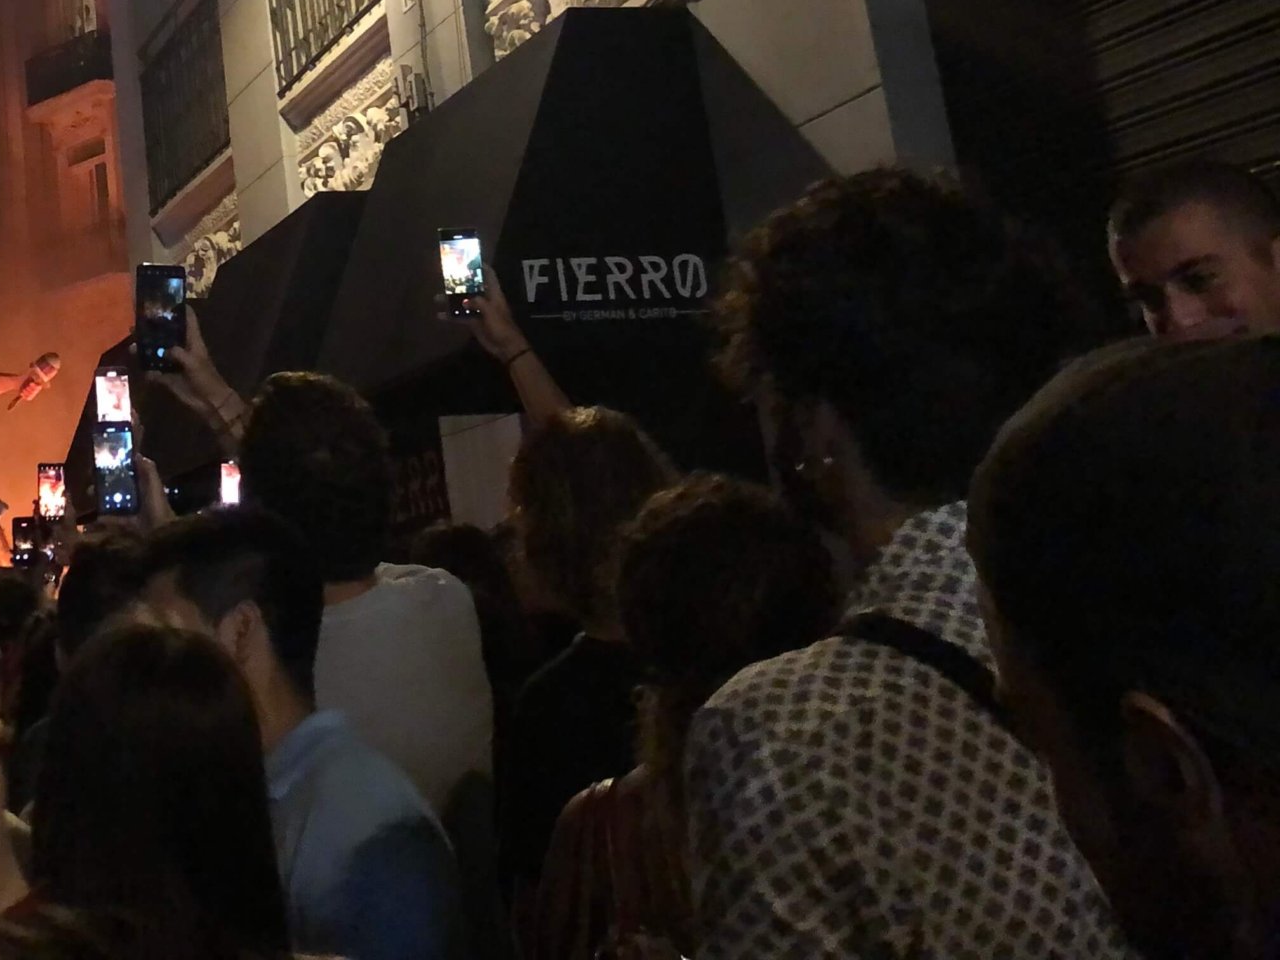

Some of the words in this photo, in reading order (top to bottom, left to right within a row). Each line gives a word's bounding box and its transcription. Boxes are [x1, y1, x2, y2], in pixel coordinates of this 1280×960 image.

[521, 253, 707, 303] FIERRO
[562, 310, 577, 321] BY
[628, 308, 636, 320] &
